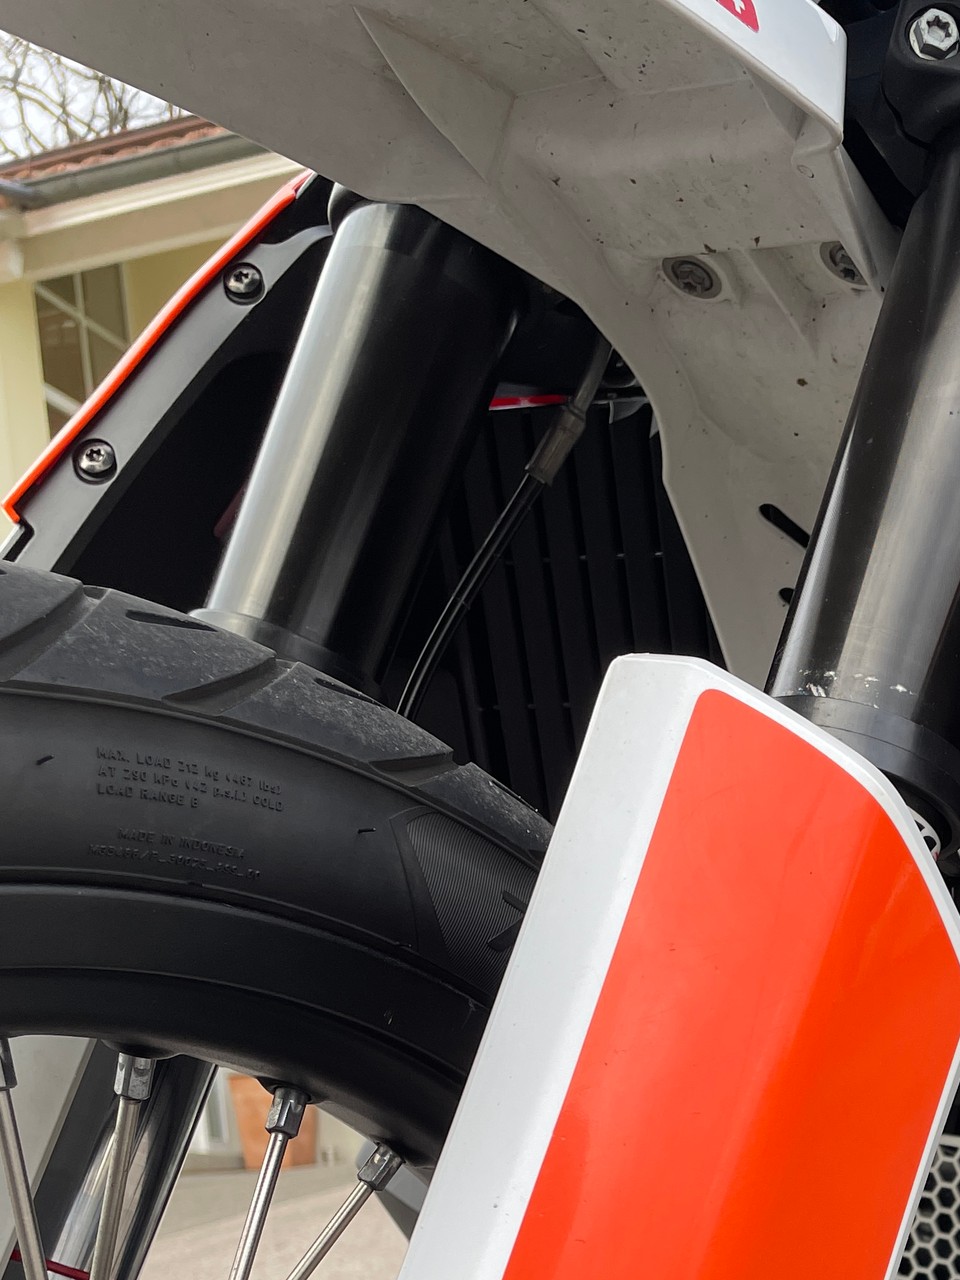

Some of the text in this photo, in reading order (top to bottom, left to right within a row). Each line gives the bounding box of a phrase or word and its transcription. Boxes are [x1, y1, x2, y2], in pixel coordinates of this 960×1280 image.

[136, 751, 172, 770] LOAD
[204, 765, 219, 782] kg
[96, 782, 134, 799] LOAD
[139, 788, 185, 807] RANGE
[97, 765, 116, 778] AT
[253, 795, 285, 812] COLD
[118, 828, 156, 844] MADE
